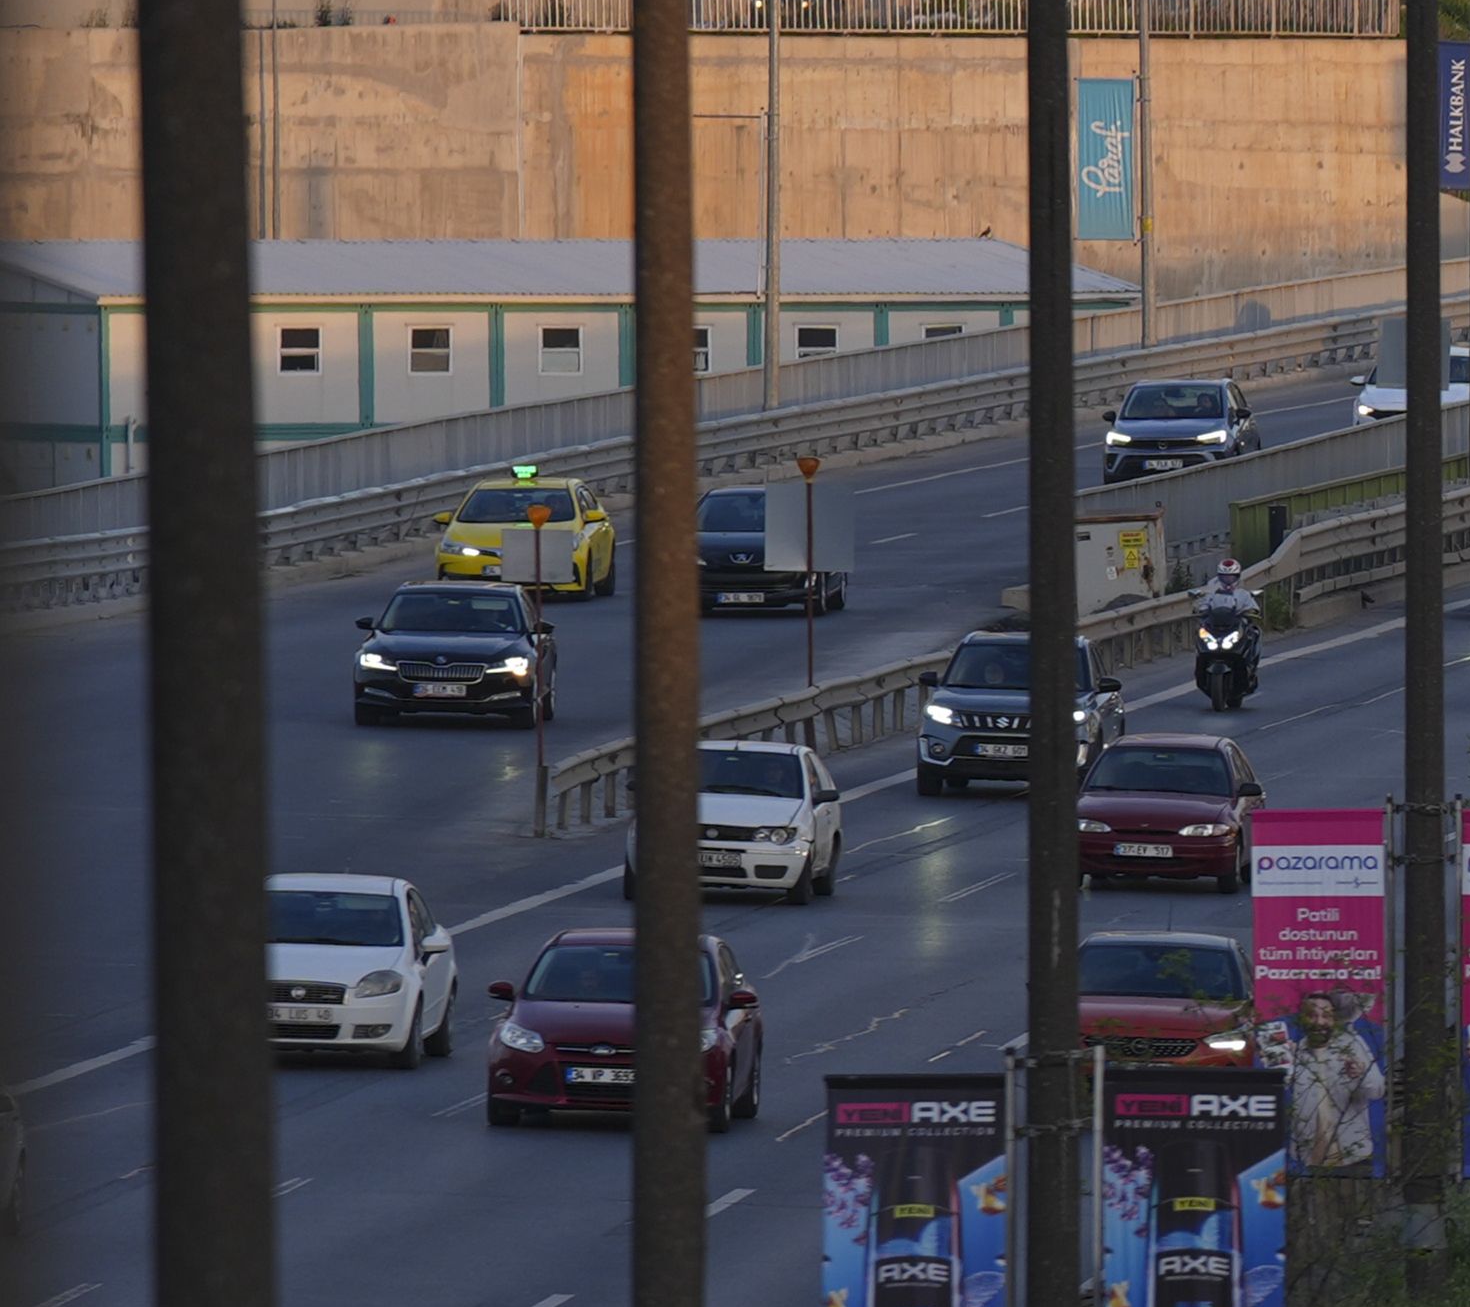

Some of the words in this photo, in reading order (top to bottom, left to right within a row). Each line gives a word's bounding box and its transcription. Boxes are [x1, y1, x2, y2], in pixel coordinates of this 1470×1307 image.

[1449, 58, 1467, 152] HALKBANK
[1080, 120, 1131, 199] Paraf
[1257, 855, 1378, 875] pazarama
[1297, 908, 1340, 922] Patili
[1278, 927, 1358, 942] dostunun
[1259, 947, 1293, 961] tüm
[1254, 965, 1381, 980] Pazarama'da!
[910, 1100, 997, 1123] AXE
[1189, 1093, 1277, 1117] AXE
[835, 1125, 902, 1137] PREMIUM
[910, 1124, 997, 1137] COLLECTION
[1114, 1119, 1181, 1130] PREMIUM
[1187, 1119, 1277, 1132] COLLECTION
[878, 1261, 951, 1284] AXE
[1158, 1255, 1230, 1277] AXE
